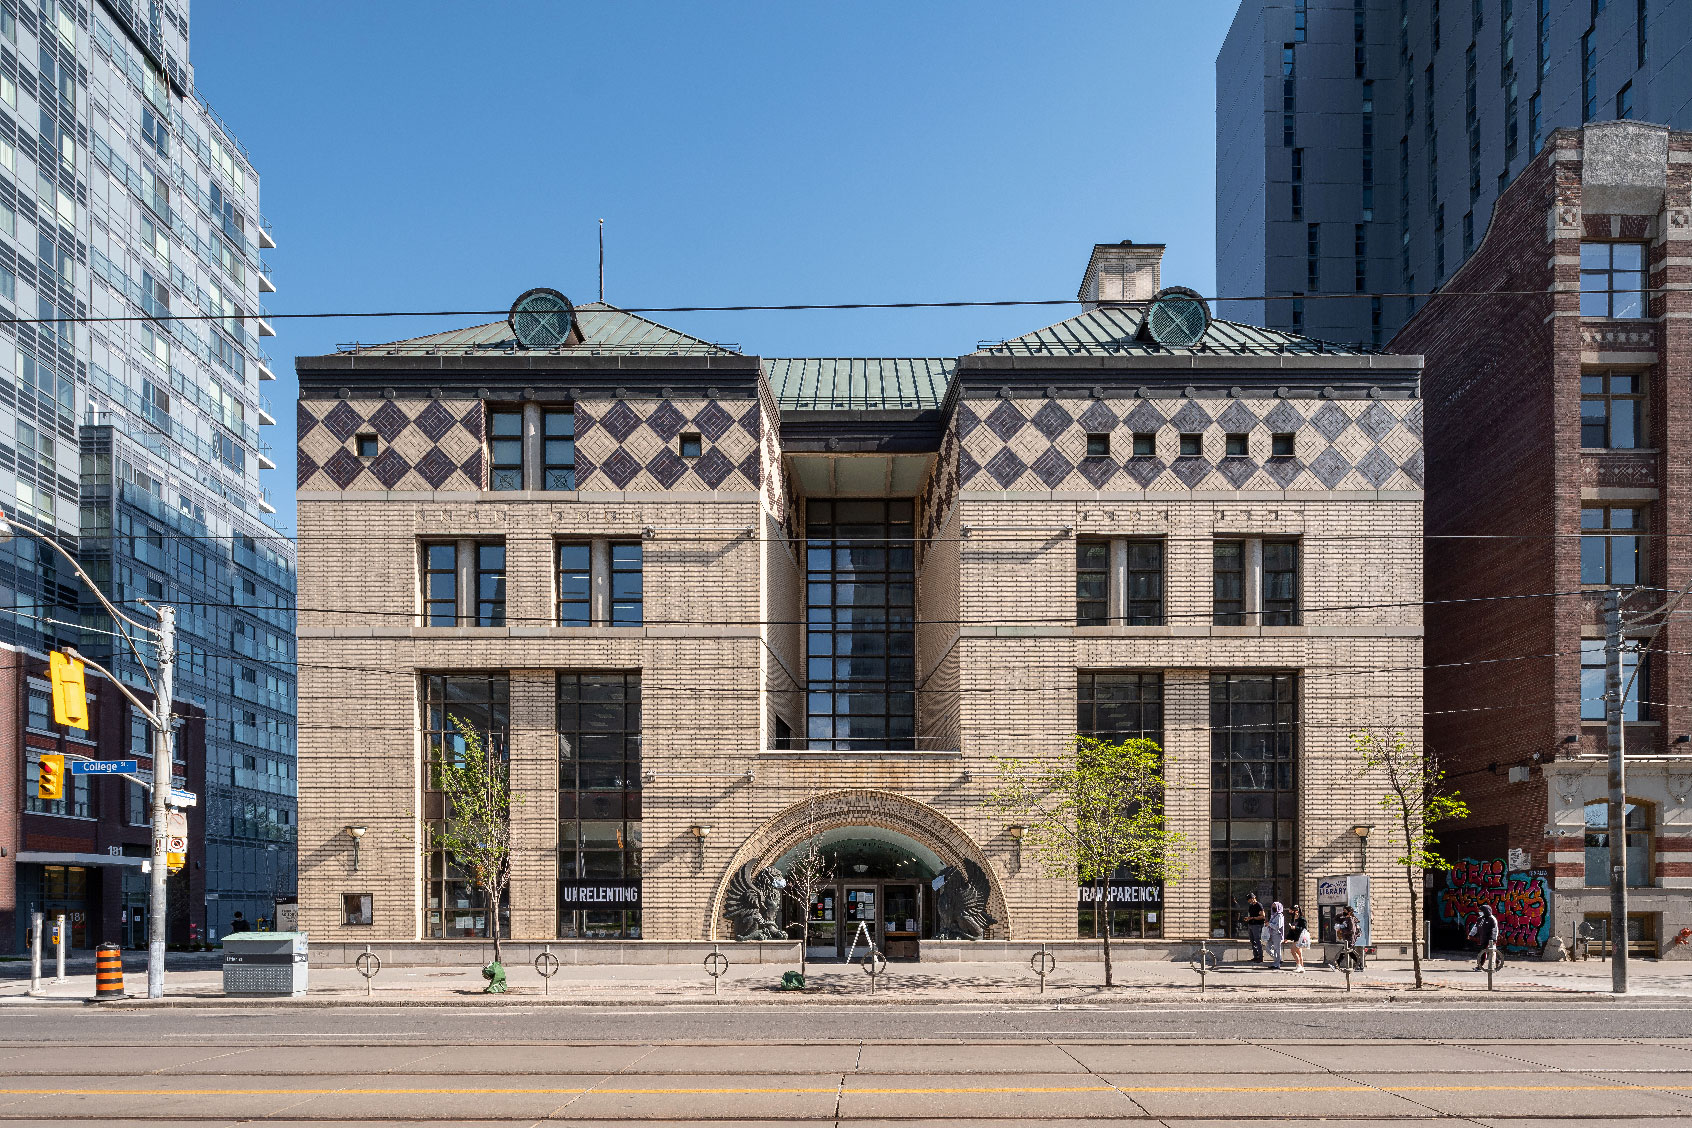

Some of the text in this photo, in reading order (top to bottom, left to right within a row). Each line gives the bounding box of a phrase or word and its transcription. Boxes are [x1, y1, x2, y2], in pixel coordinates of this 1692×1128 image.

[83, 762, 117, 772] College
[108, 845, 123, 857] 181
[564, 886, 638, 902] UNRELENTING
[1319, 887, 1347, 896] LIBRARY
[69, 912, 85, 921] 181
